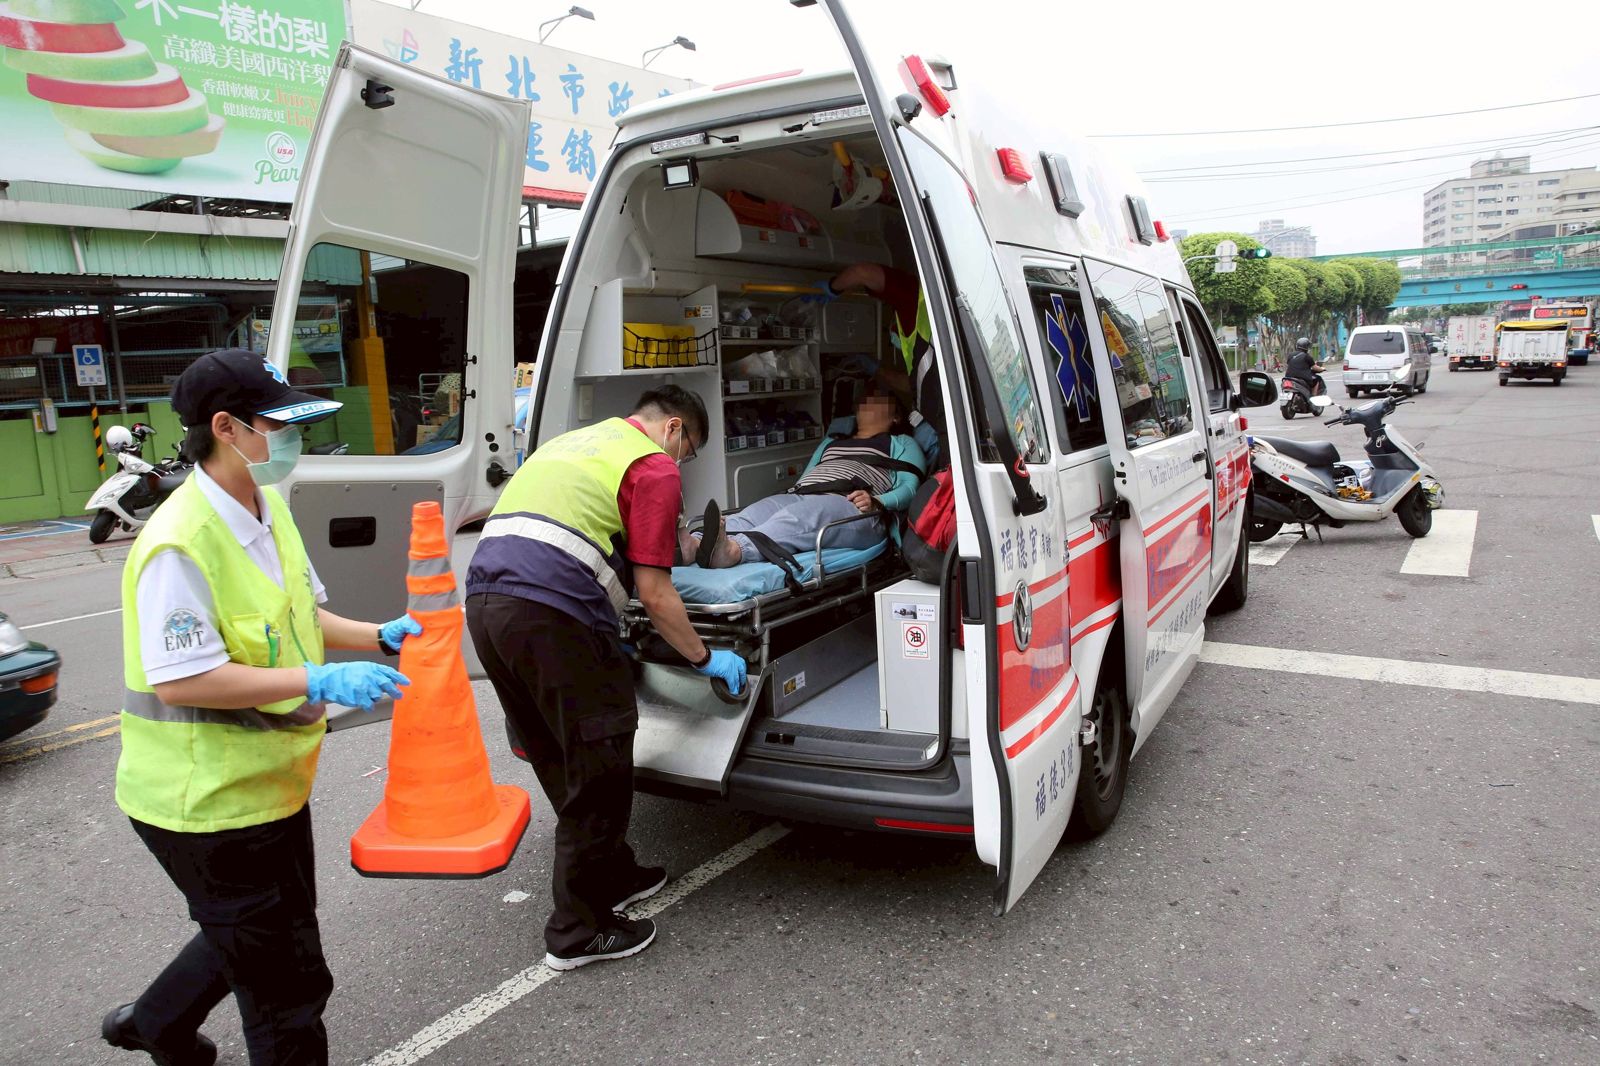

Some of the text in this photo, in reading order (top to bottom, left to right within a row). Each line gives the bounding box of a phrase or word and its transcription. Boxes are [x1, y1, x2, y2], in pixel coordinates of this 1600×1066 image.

[135, 0, 330, 59] 不一樣的梨
[162, 34, 331, 86] 高纖美國西洋梨
[202, 78, 273, 102] 香甜軟嫩又
[223, 101, 286, 123] 健康窈窕更
[276, 147, 294, 156] USA
[290, 402, 327, 418] EMS
[164, 629, 205, 652] EMT
[910, 630, 922, 643] 油
